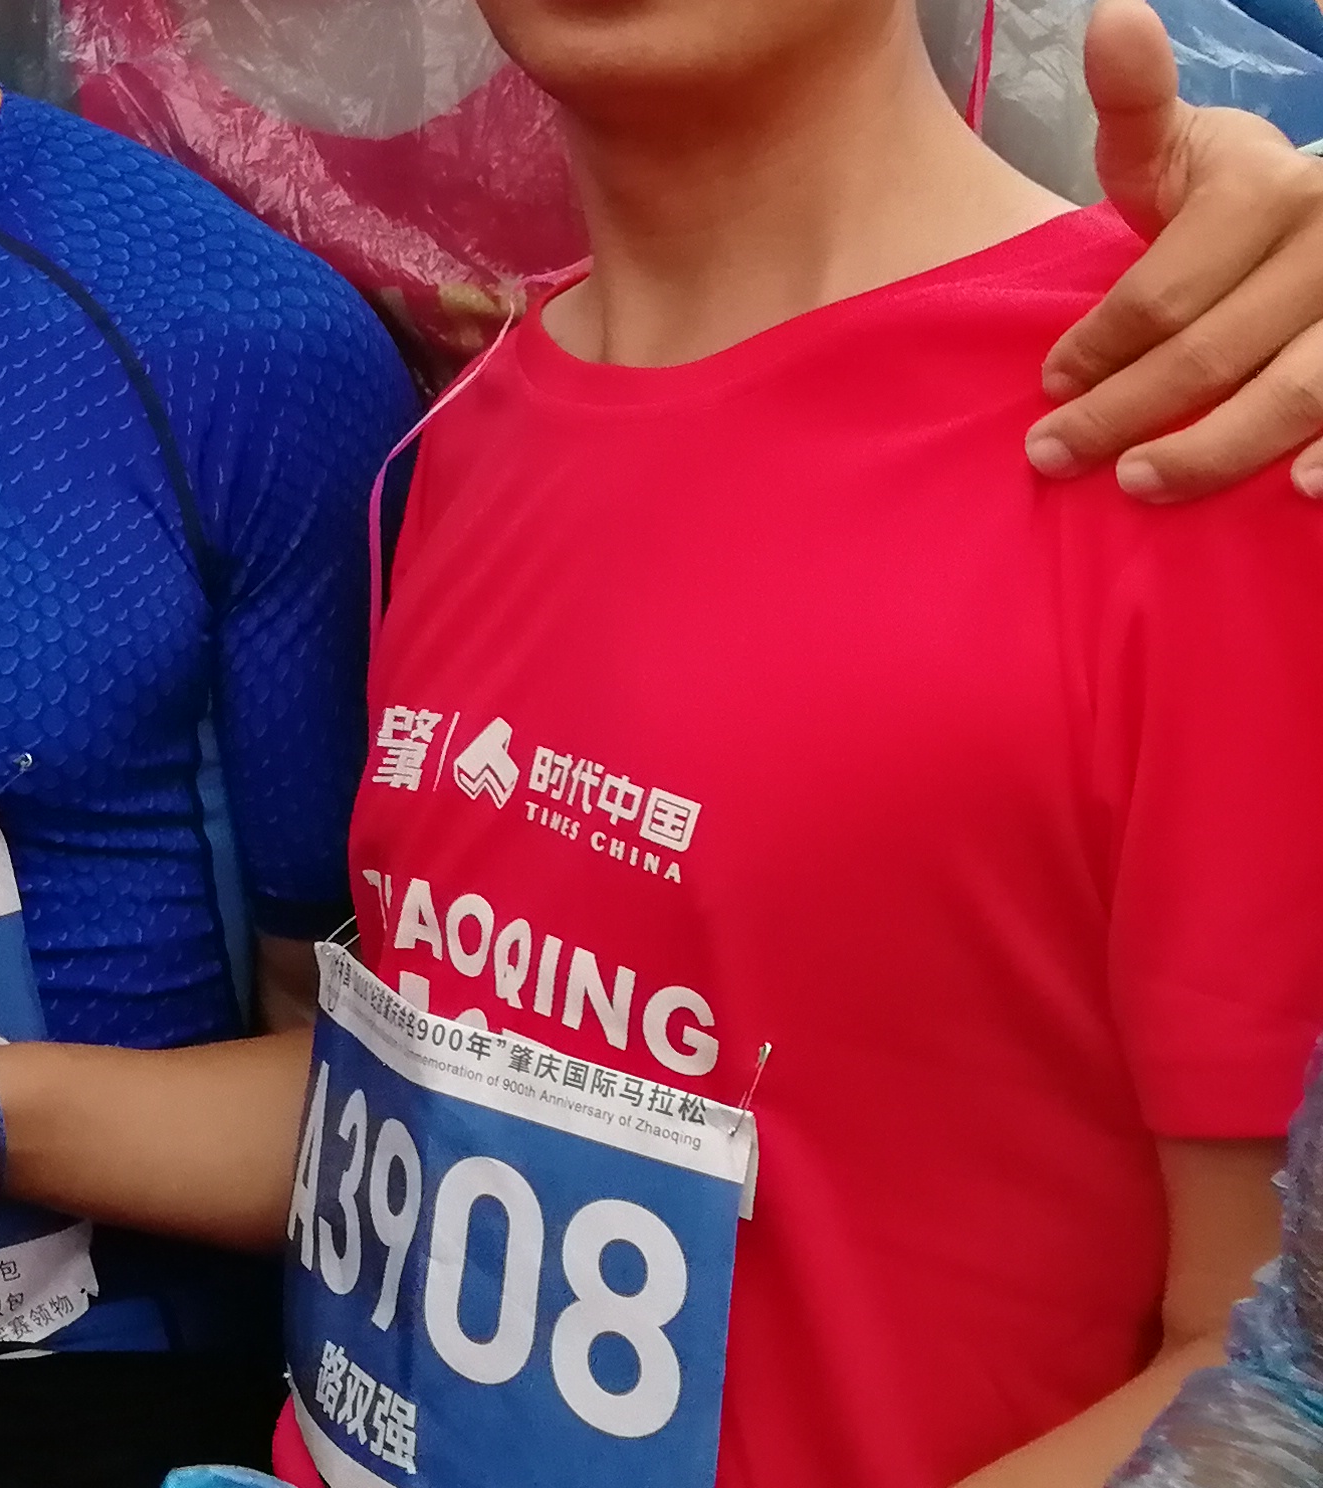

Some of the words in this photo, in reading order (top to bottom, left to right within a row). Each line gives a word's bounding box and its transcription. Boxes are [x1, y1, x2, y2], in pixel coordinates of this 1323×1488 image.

[525, 800, 581, 841] TIMES
[590, 831, 682, 884] CHINA
[529, 745, 702, 853] 时代中国
[362, 868, 720, 1077] AOQING
[487, 1072, 500, 1087] of
[502, 1078, 536, 1099] 900th
[540, 1090, 615, 1126] Anniversary
[619, 1114, 632, 1127] of
[636, 1118, 702, 1152] Zhaoqing
[287, 1060, 687, 1439] A3908
[315, 1339, 417, 1475] 路双强
